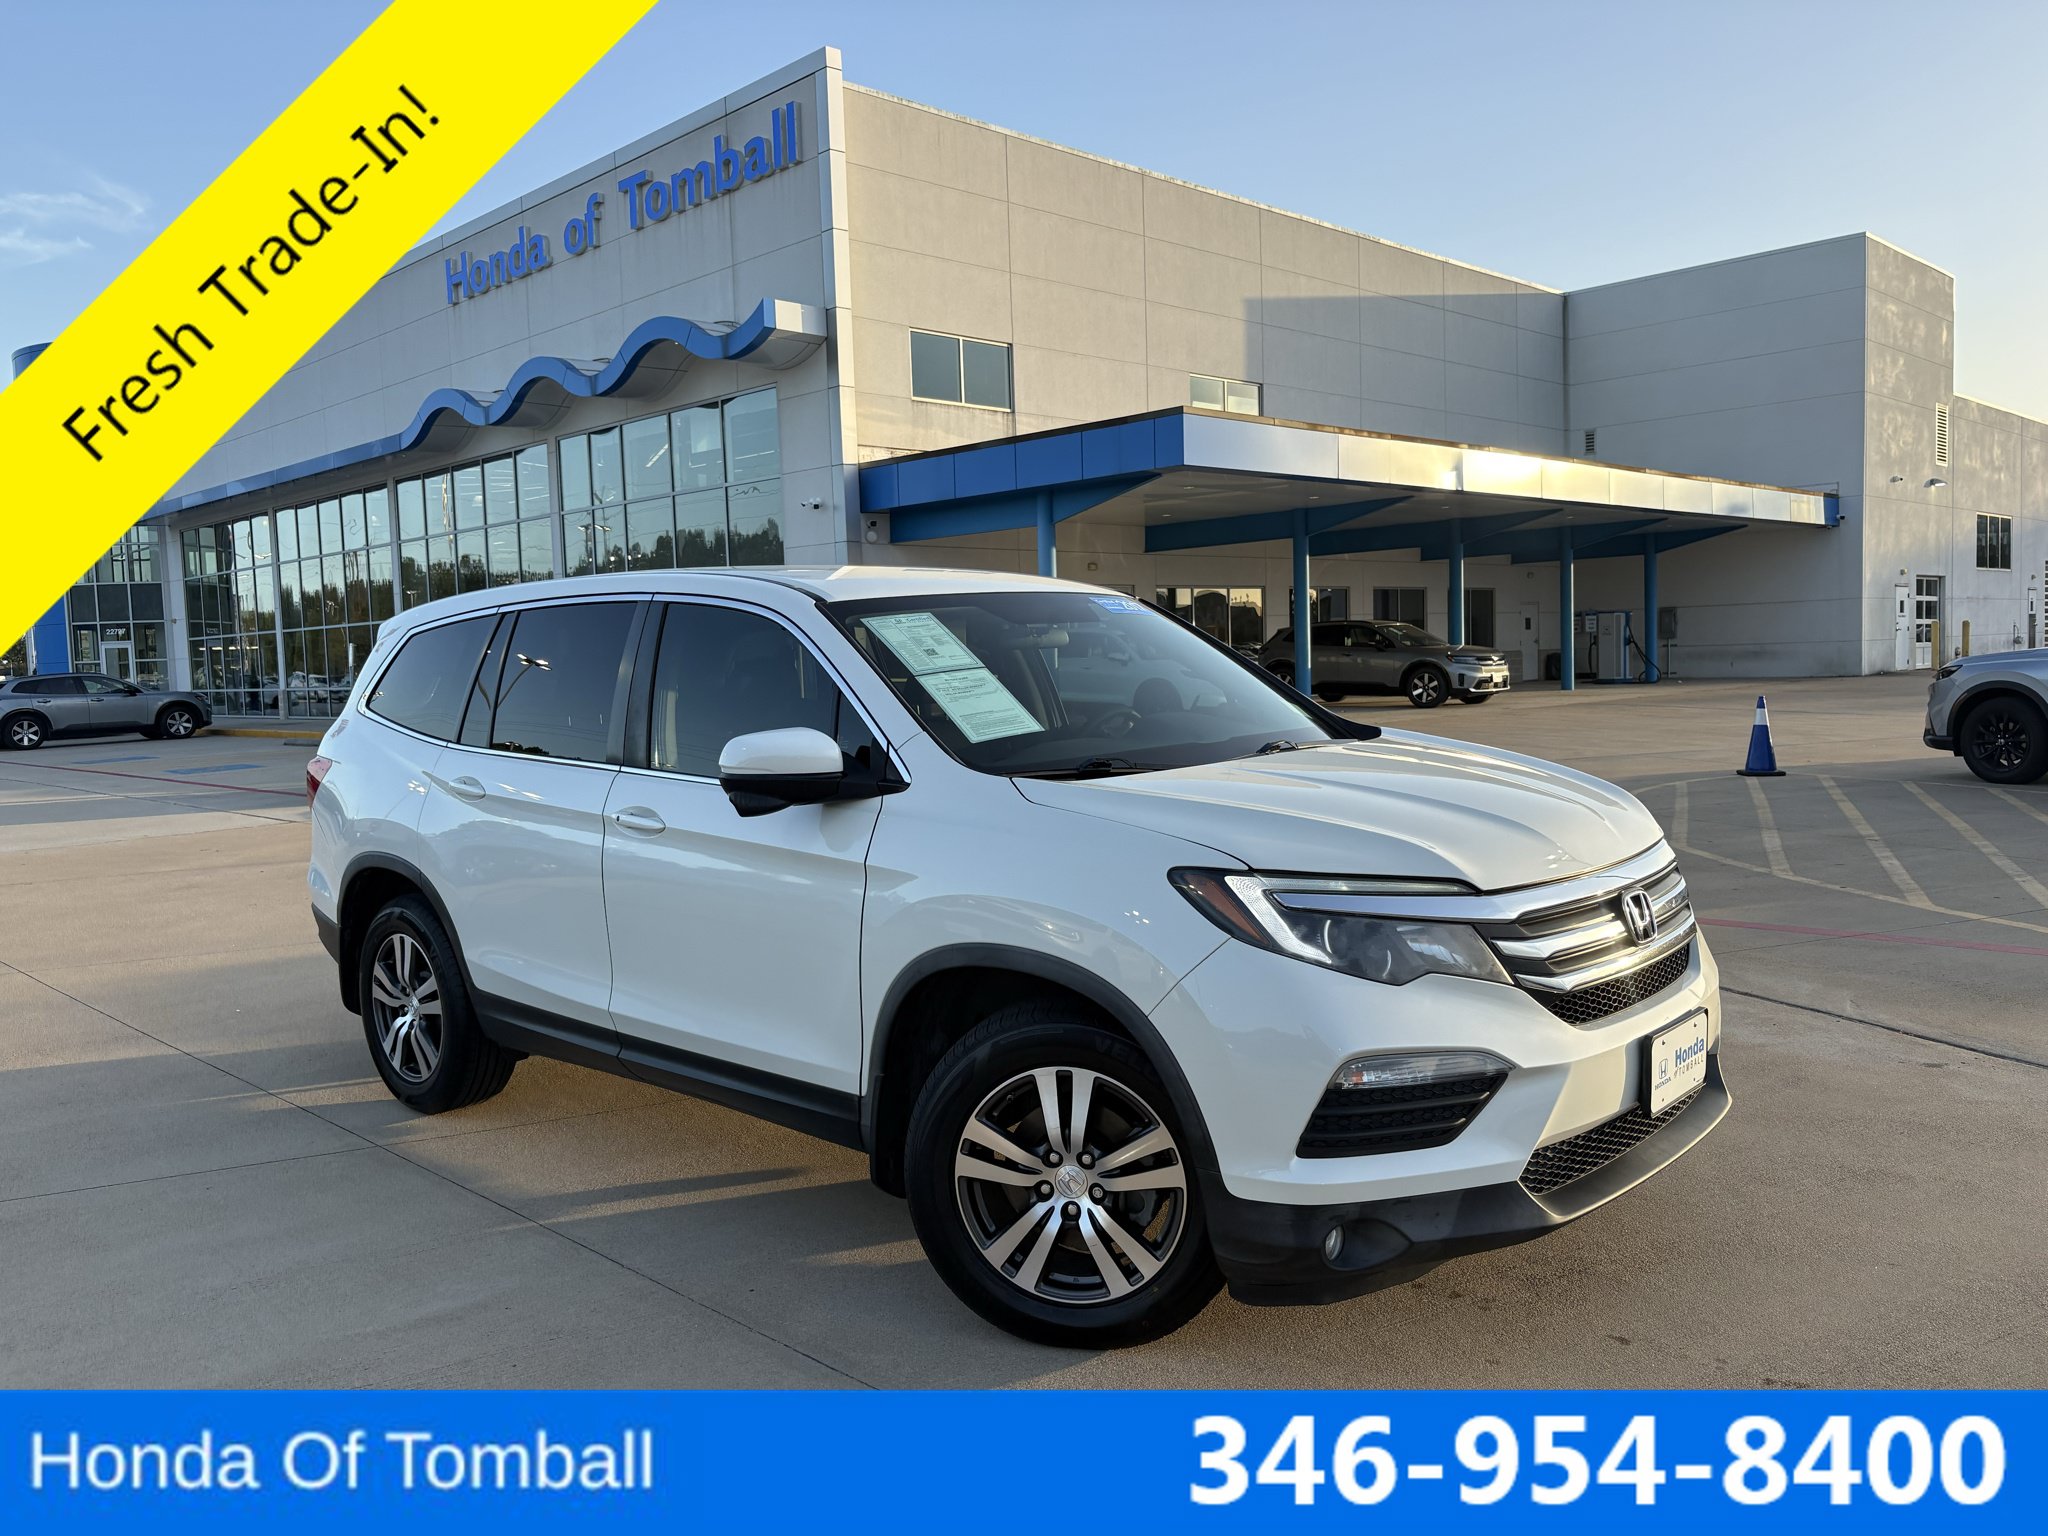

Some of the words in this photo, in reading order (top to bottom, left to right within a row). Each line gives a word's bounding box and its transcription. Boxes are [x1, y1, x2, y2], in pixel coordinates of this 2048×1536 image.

[444, 225, 551, 305] Honda
[563, 191, 602, 256] of
[617, 100, 802, 231] Tomball
[1675, 1036, 1704, 1067] Honda
[1679, 1053, 1704, 1077] TOMBALL
[1655, 1076, 1671, 1090] HONDA
